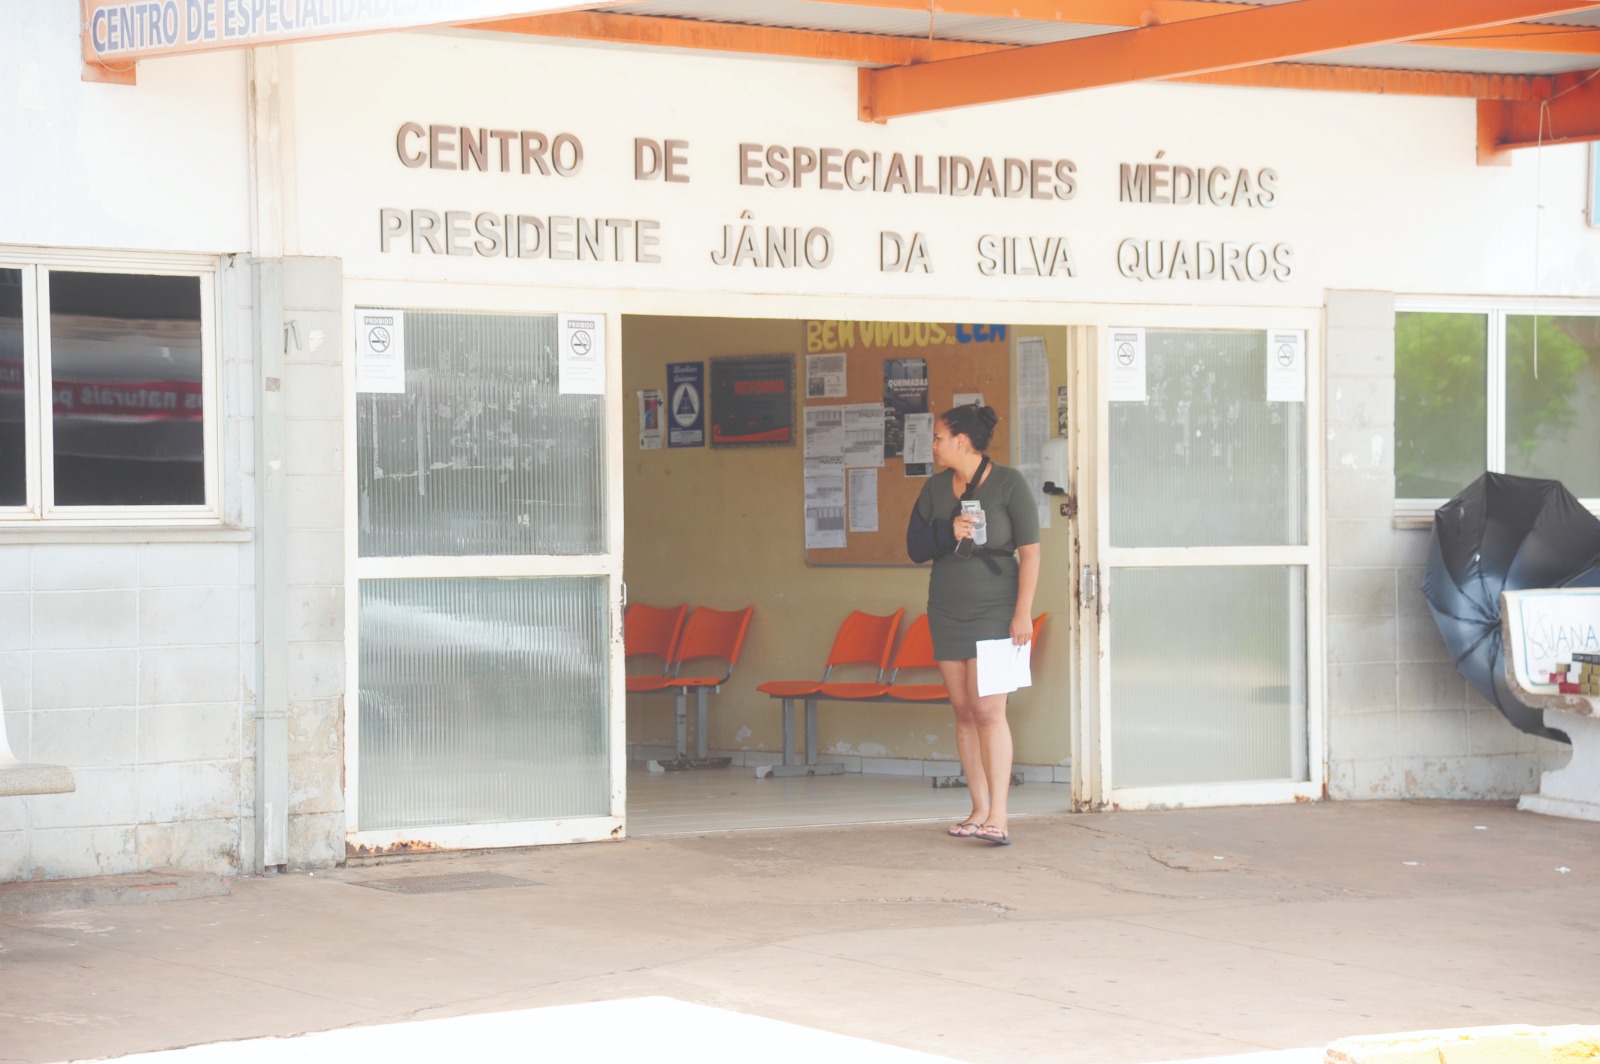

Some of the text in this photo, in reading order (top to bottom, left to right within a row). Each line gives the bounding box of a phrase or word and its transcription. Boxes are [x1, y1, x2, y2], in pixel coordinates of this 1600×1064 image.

[92, 1, 179, 53] CENTRO
[187, 0, 217, 42] DE
[396, 121, 1280, 209] CENTRO DE ESPECIALIDADES MÉDICAS
[379, 207, 1295, 283] PRESIDENTE JÂNIO DA SILVA QUADROS
[365, 317, 393, 326] PROIBIDO
[887, 378, 929, 390] QUEIMADAS
